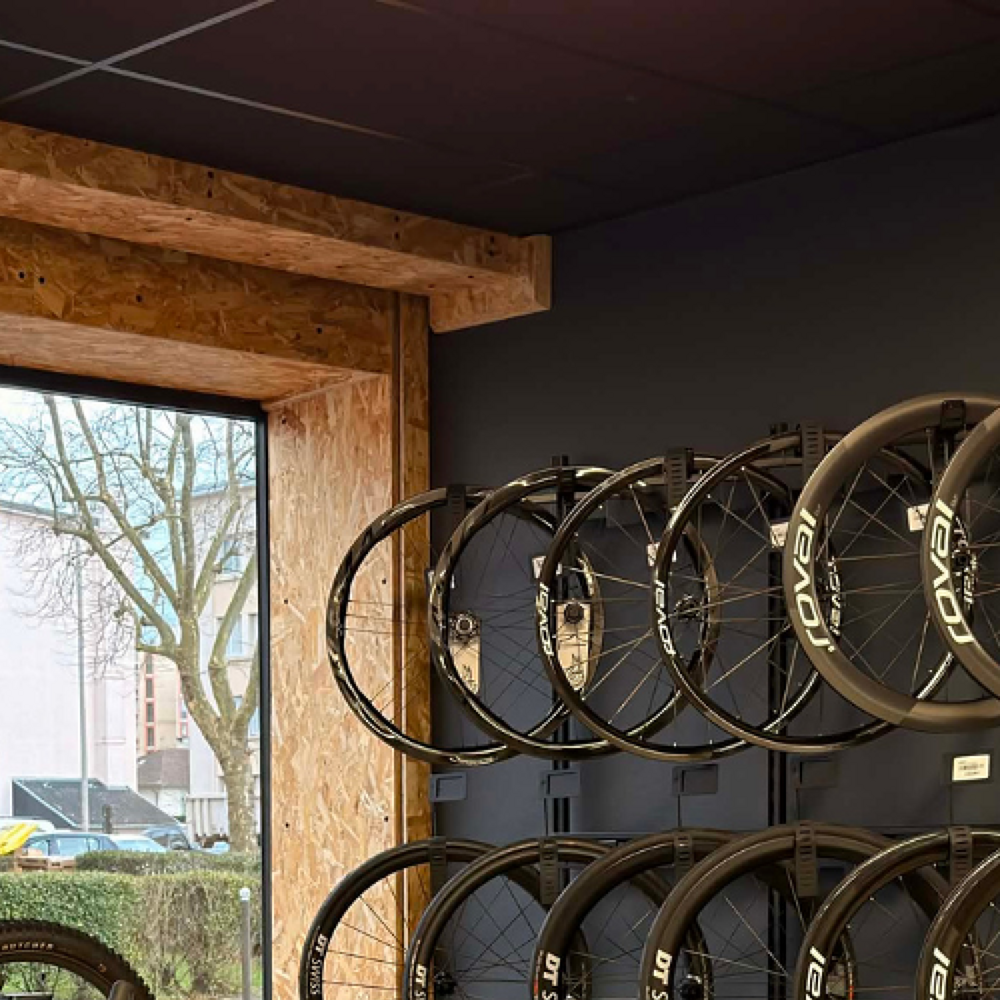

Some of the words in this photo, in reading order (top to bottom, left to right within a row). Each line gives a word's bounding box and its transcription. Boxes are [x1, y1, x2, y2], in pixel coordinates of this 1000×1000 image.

[315, 933, 328, 957] DT
[310, 958, 322, 995] SWISS
[415, 964, 427, 988] DT
[543, 952, 561, 986] DT
[653, 949, 673, 985] DT
